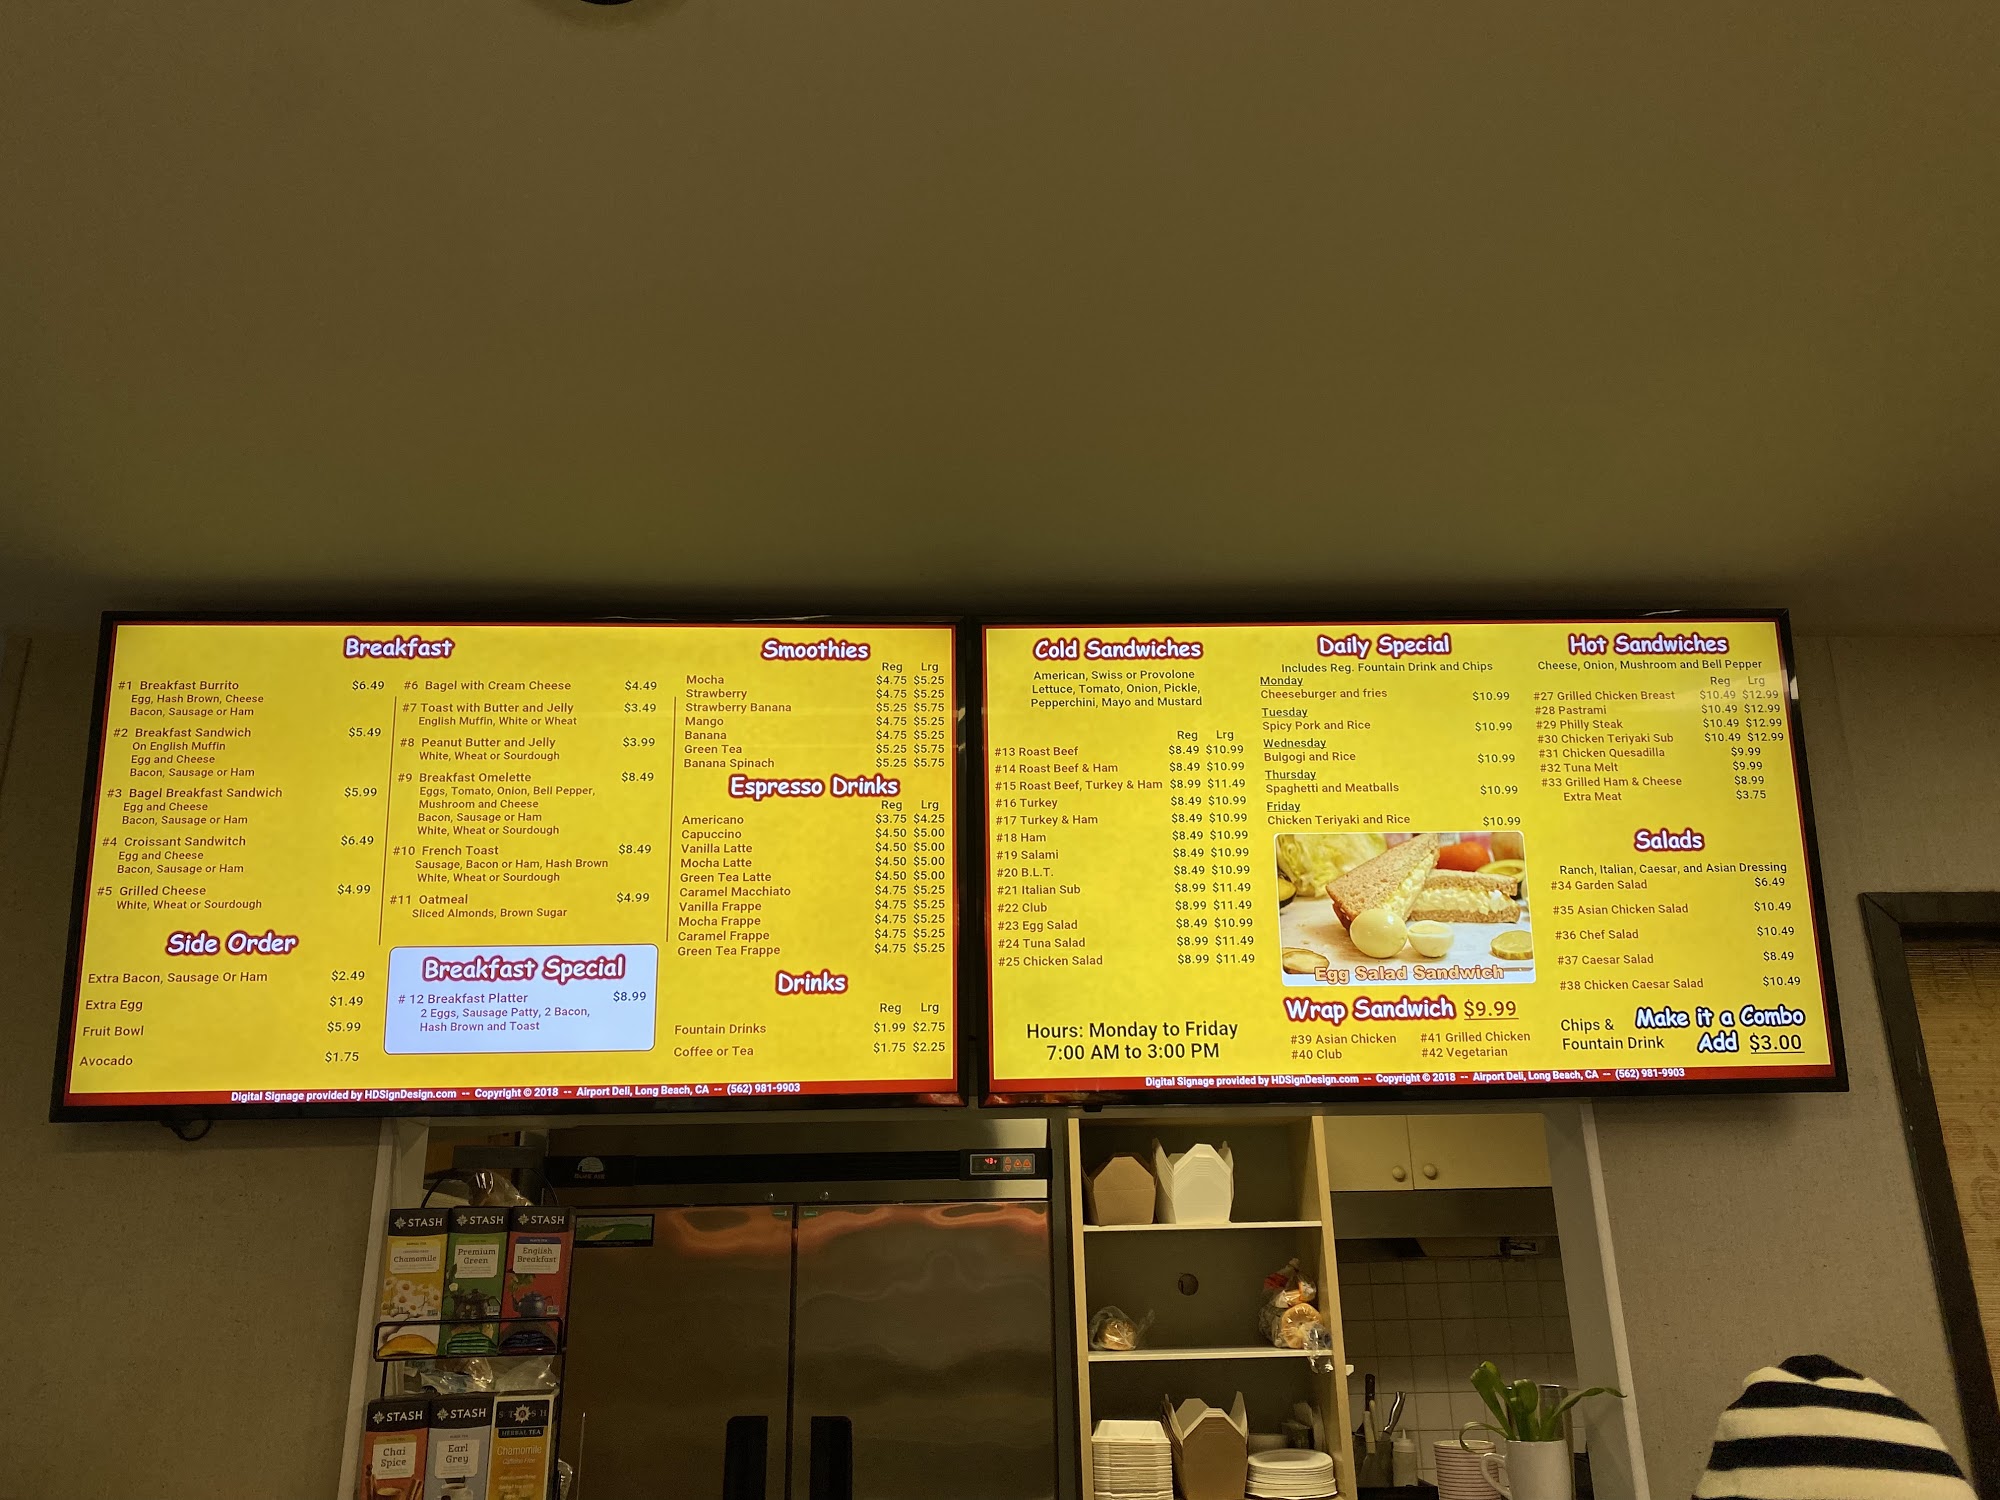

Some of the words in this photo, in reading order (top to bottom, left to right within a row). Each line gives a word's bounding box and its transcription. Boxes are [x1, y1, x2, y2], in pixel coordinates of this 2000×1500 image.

[345, 637, 453, 659] Breakfast
[762, 638, 870, 660] Smoothies
[1034, 640, 1077, 658] Cold
[1085, 639, 1202, 658] Sandwiches
[1318, 636, 1370, 657] Daily
[1378, 635, 1450, 657] Special
[1569, 634, 1607, 654] Hot
[1615, 634, 1728, 653] Sandwiches
[882, 662, 903, 674] Reg
[921, 662, 939, 674] Lrg
[686, 674, 724, 684] Mocha
[876, 674, 907, 686] $4.75
[913, 675, 945, 686] $5.25
[1033, 670, 1088, 682] American,
[1091, 670, 1123, 680] Swiss
[1140, 669, 1195, 679] Provolone
[1260, 675, 1303, 688] Monday
[118, 681, 132, 690] #1
[140, 680, 196, 690] Breakfast
[199, 680, 239, 690] Burrito
[352, 680, 385, 691] $6.49
[404, 681, 419, 690] #6
[425, 680, 457, 693] Bagel
[460, 680, 484, 690] with
[488, 681, 525, 690] Cream
[529, 680, 571, 690] Cheese
[625, 680, 657, 691] $4.49
[1261, 707, 1308, 719] Tuesday
[1535, 706, 1556, 715] #28
[1558, 705, 1607, 715] Pastrami
[1701, 704, 1738, 714] $10.49
[1744, 703, 1781, 714] $12.99
[1177, 730, 1198, 742] Reg
[1216, 730, 1234, 742] Lrg
[1168, 745, 1200, 755] $8.49
[1206, 744, 1244, 755] $10.99
[1263, 738, 1327, 750] Wednesday
[994, 747, 1016, 757] #13
[1019, 747, 1050, 756] Roast
[1053, 746, 1078, 756] Beef
[1264, 769, 1316, 782] Thursday
[730, 776, 824, 800] Espresso
[832, 775, 899, 796] Drinks
[1267, 801, 1301, 814] Friday
[681, 814, 744, 825] Americano
[875, 813, 907, 825] $3.75
[913, 812, 945, 824] $4.25
[1636, 828, 1703, 850] Salads
[997, 868, 1018, 878] #20
[1021, 867, 1054, 877] B.L.T.
[1173, 865, 1205, 876] $8.49
[1211, 864, 1250, 875] $10.99
[1551, 881, 1572, 890] #34
[1575, 879, 1614, 890] Garden
[1617, 878, 1648, 890] Salad
[1754, 877, 1785, 887] $6.49
[97, 886, 112, 896] #5
[119, 885, 159, 896] Grilled
[162, 885, 206, 896] Cheese
[337, 883, 371, 895] $4.99
[390, 895, 411, 905] #11
[419, 893, 468, 905] Oatmeal
[616, 892, 650, 904] $4.99
[412, 909, 445, 918] Sliced
[447, 908, 497, 919] Almonds,
[500, 908, 533, 917] Brown
[536, 908, 568, 919] Sugar
[167, 933, 218, 954] Side
[227, 931, 297, 953] Order
[424, 958, 536, 981] Breakfast
[544, 956, 626, 984] Special
[1314, 966, 1350, 984] Egg
[1356, 966, 1406, 980] Salad
[1414, 965, 1504, 980] Sandwich
[777, 971, 846, 994] Drinks
[329, 995, 363, 1007] $1.49
[398, 994, 406, 1004] #
[410, 994, 424, 1004] 12
[428, 993, 485, 1004] Breakfast
[488, 992, 528, 1003] Platter
[613, 991, 647, 1002] $8.99
[85, 1000, 116, 1010] Extra
[120, 999, 143, 1012] Egg
[1285, 998, 1346, 1024] Wrap
[1353, 996, 1455, 1020] Sandwich
[1464, 998, 1519, 1021] $9.99
[1636, 1007, 1689, 1029] Make
[1696, 1008, 1713, 1027] it
[1720, 1010, 1734, 1026] a
[1740, 1004, 1805, 1026] Combo
[675, 1024, 725, 1035] Fountain
[729, 1023, 766, 1034] Drinks
[873, 1022, 906, 1034] $1.99
[913, 1021, 945, 1033] $2.75
[1027, 1023, 1083, 1039] Hours:
[1089, 1021, 1158, 1041] Monday
[1162, 1022, 1180, 1036] to
[1185, 1020, 1238, 1040] Friday
[1561, 1018, 1600, 1034] Chips
[1604, 1018, 1615, 1031] &
[1562, 1036, 1624, 1050] Fountain
[1627, 1035, 1665, 1049] Drink
[1698, 1032, 1738, 1052] Add
[1749, 1032, 1805, 1055] $3.00
[1047, 1045, 1085, 1060] 7:00
[1090, 1044, 1119, 1060] AM
[1124, 1044, 1142, 1059] to
[1147, 1043, 1185, 1059] 3:00
[1191, 1043, 1219, 1058] PM
[231, 1092, 262, 1102] Digital
[265, 1091, 304, 1102] Signage
[307, 1090, 348, 1101] provided
[351, 1090, 363, 1101] by
[364, 1089, 456, 1100] HDSignDesign.com
[474, 1088, 521, 1100] Copyright
[534, 1088, 558, 1096] 2018
[576, 1087, 609, 1098] Airport
[612, 1086, 632, 1097] Deli,
[635, 1086, 658, 1097] Long
[661, 1085, 692, 1096] Beach,
[695, 1085, 709, 1094] CA
[727, 1084, 752, 1095] (562)
[755, 1083, 800, 1093] 981-9903
[408, 1218, 443, 1227] STASH
[470, 1216, 504, 1225] STASH
[530, 1215, 565, 1225] STASH
[458, 1248, 496, 1256] Premium
[522, 1247, 553, 1256] English
[394, 1255, 436, 1263] Chamomile
[517, 1255, 557, 1263] Breakfast
[386, 1410, 423, 1422] STASH
[450, 1408, 486, 1418] STASH
[383, 1447, 406, 1457] Chai
[448, 1444, 468, 1453] Earl
[497, 1446, 542, 1455] Chamomile
[380, 1459, 406, 1468] Spice
[446, 1455, 468, 1465] Grey
